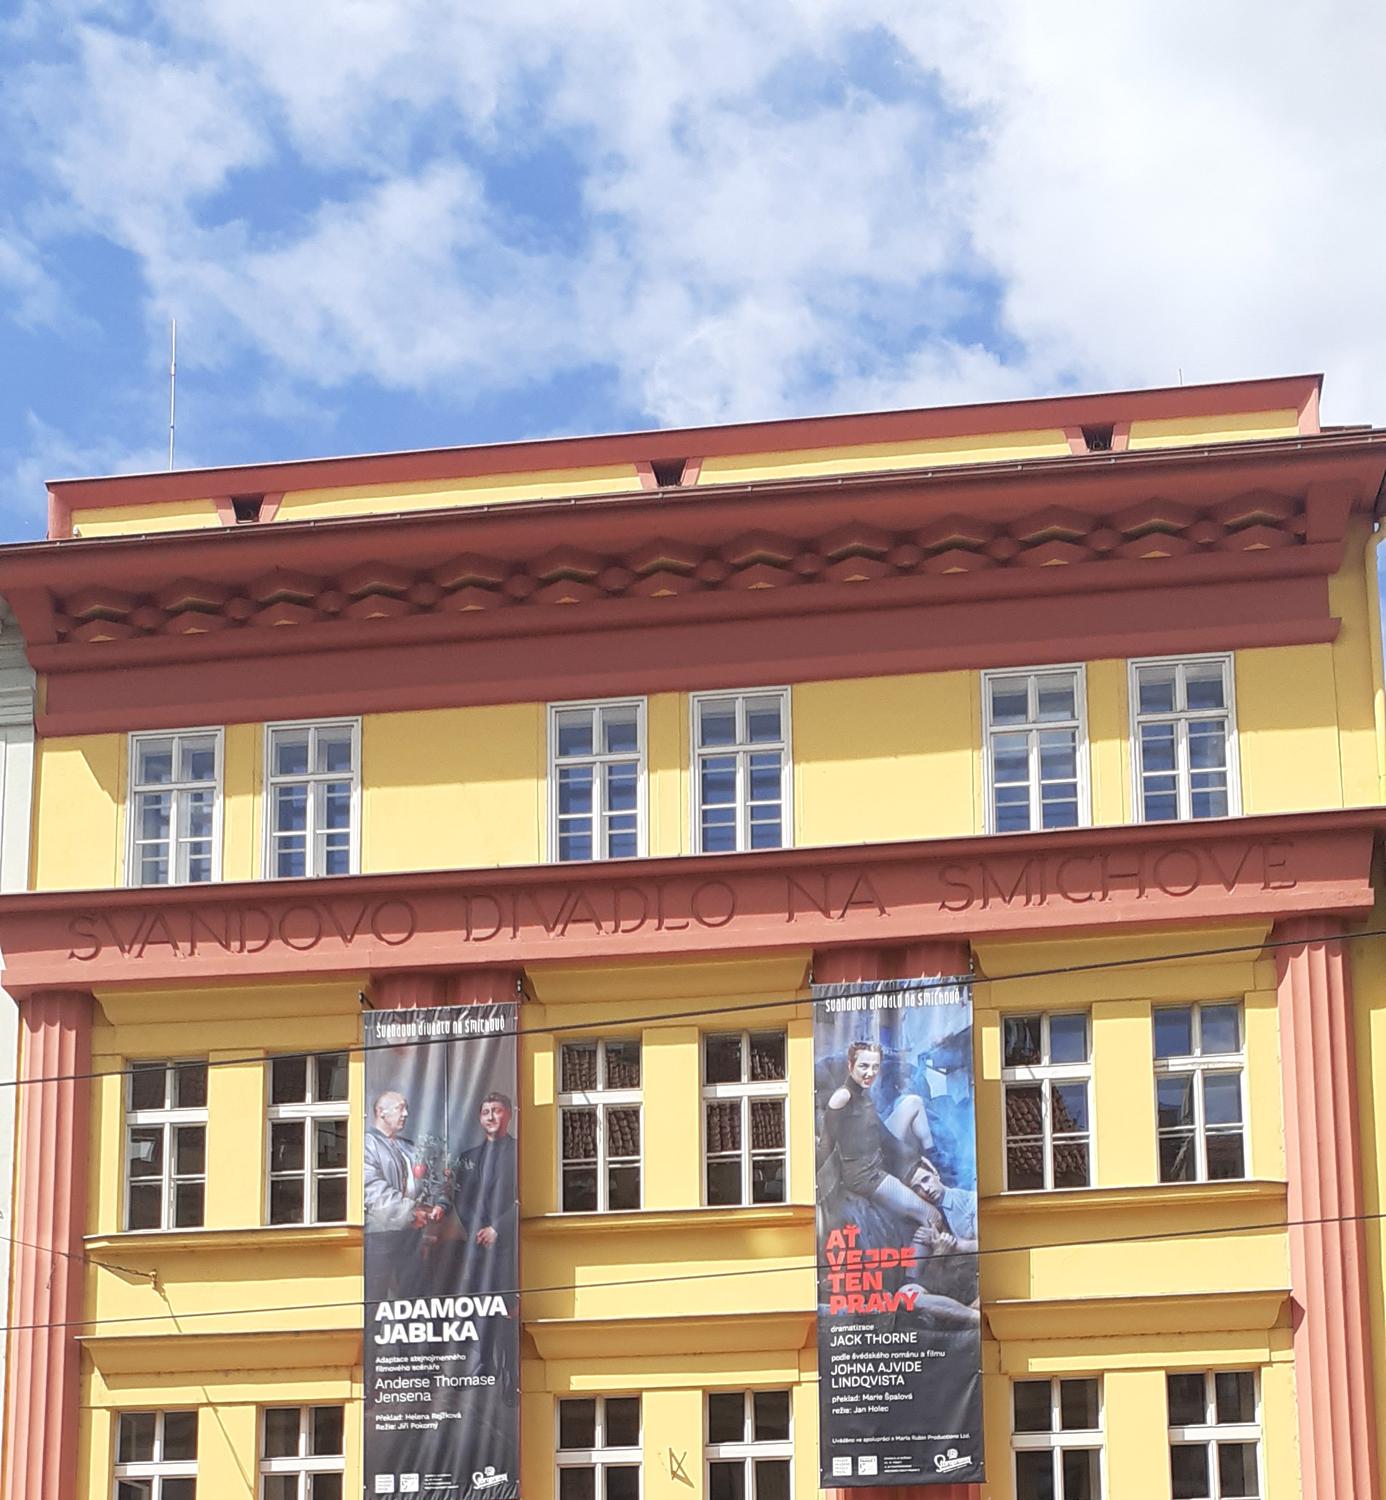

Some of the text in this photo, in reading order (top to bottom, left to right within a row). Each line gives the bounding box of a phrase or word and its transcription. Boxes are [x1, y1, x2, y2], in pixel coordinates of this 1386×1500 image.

[463, 880, 737, 942] DIVADLO
[786, 876, 891, 924] NA
[826, 1248, 918, 1271] VEJDE
[828, 1271, 882, 1293] TEN
[375, 1295, 507, 1321] ADAMOVA
[830, 1288, 919, 1315] PRAVÝ
[374, 1321, 479, 1345] JABLKA
[831, 1324, 874, 1333] dramatizace
[830, 1332, 917, 1347] JACK THORNE
[376, 1356, 409, 1365] Adaptace
[831, 1353, 850, 1362] podle
[926, 1349, 945, 1357] filmu
[831, 1361, 922, 1375] JOHNA AJVIDE
[375, 1375, 495, 1389] Anderse Thomase
[831, 1375, 905, 1388] LINDQVISTA
[375, 1391, 432, 1403] Jensena
